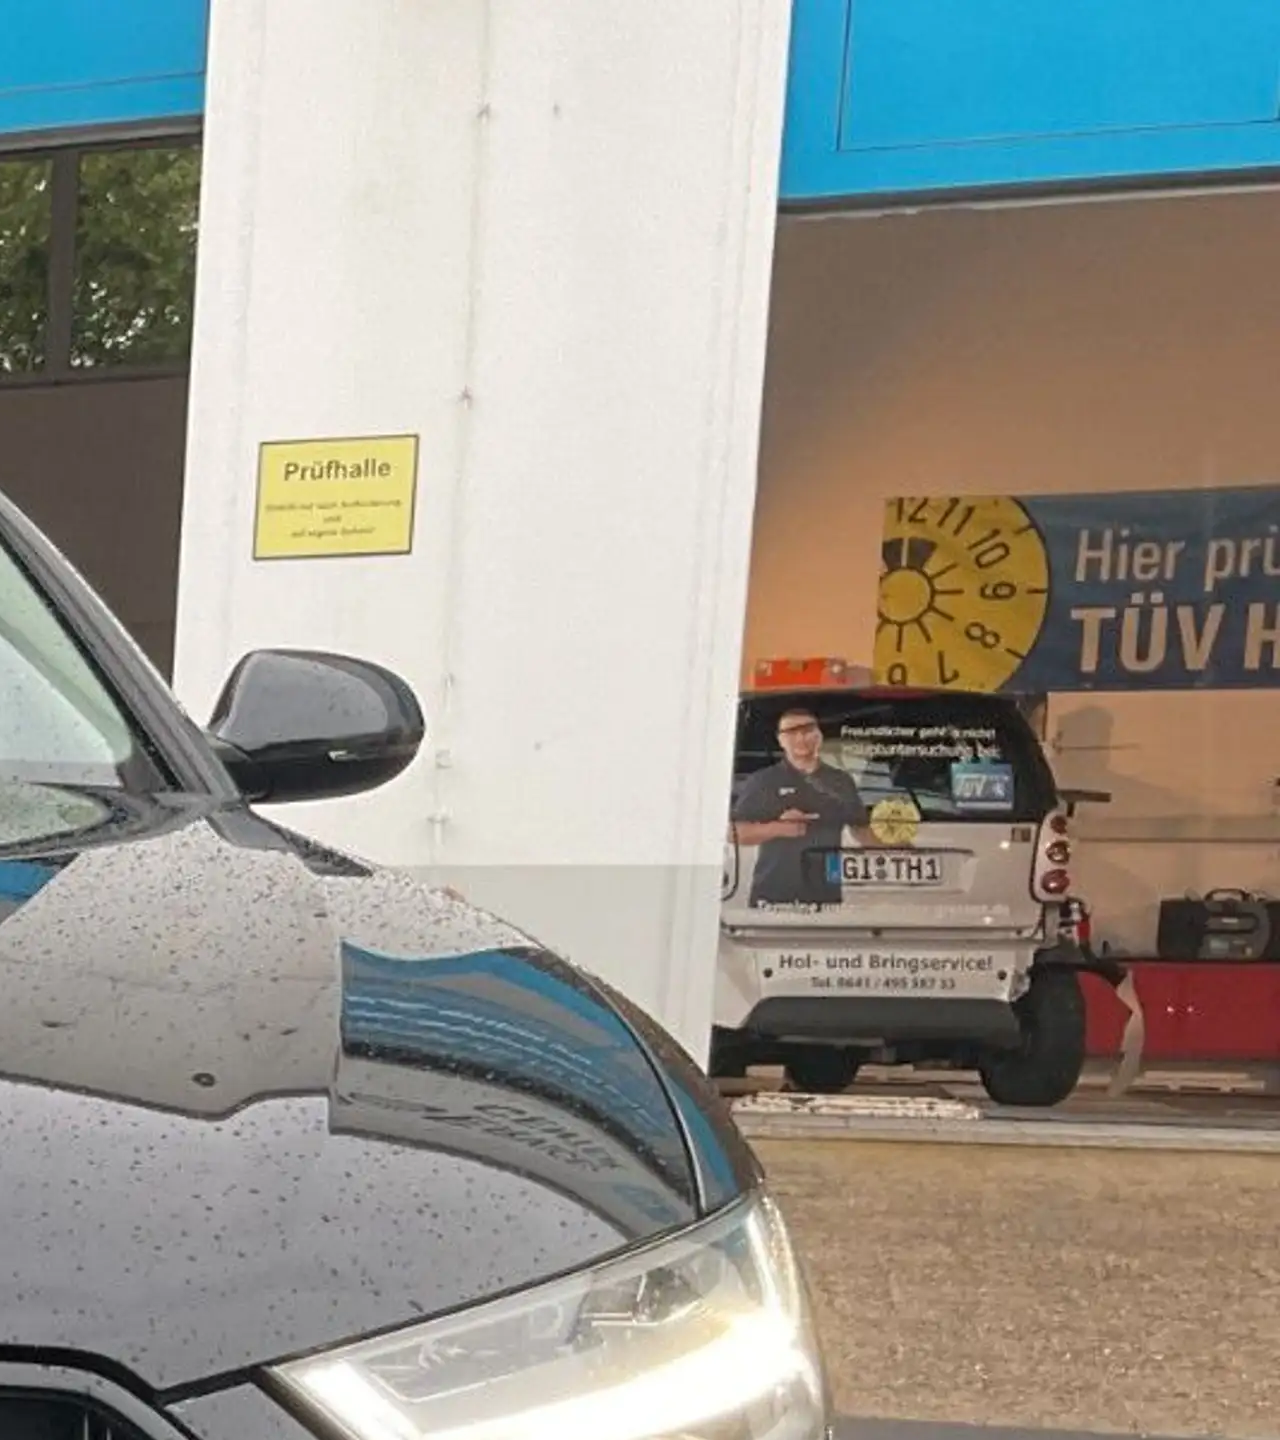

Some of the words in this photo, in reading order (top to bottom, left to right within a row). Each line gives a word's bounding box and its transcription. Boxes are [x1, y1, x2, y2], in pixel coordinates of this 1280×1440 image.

[283, 458, 392, 482] Prüfhalle
[1075, 528, 1186, 583] Hier
[1070, 591, 1225, 673] TÜV
[779, 954, 818, 969] Hol-
[826, 954, 862, 970] und
